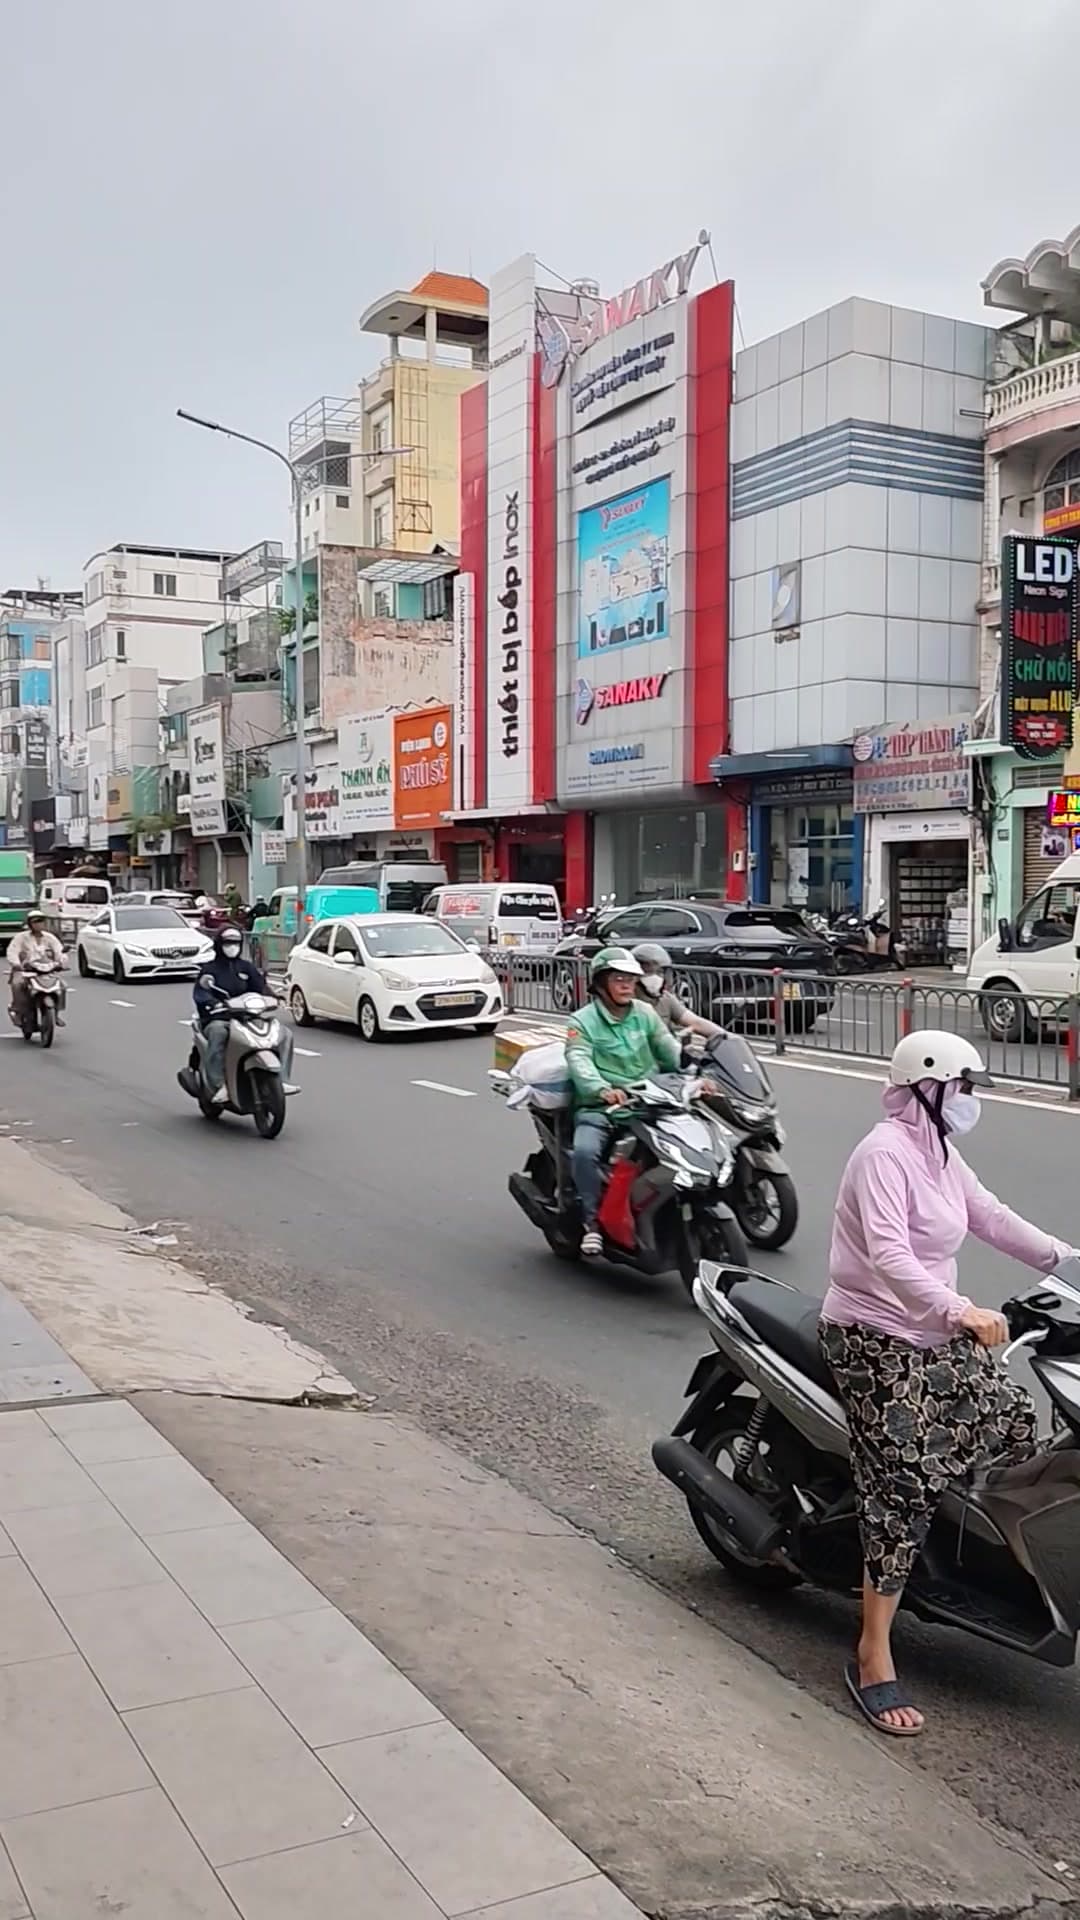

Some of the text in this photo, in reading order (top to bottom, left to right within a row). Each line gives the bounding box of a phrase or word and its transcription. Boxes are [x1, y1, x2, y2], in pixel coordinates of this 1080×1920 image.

[1016, 543, 1073, 583] LED
[594, 673, 668, 710] SANAKY
[1050, 690, 1072, 711] ALU
